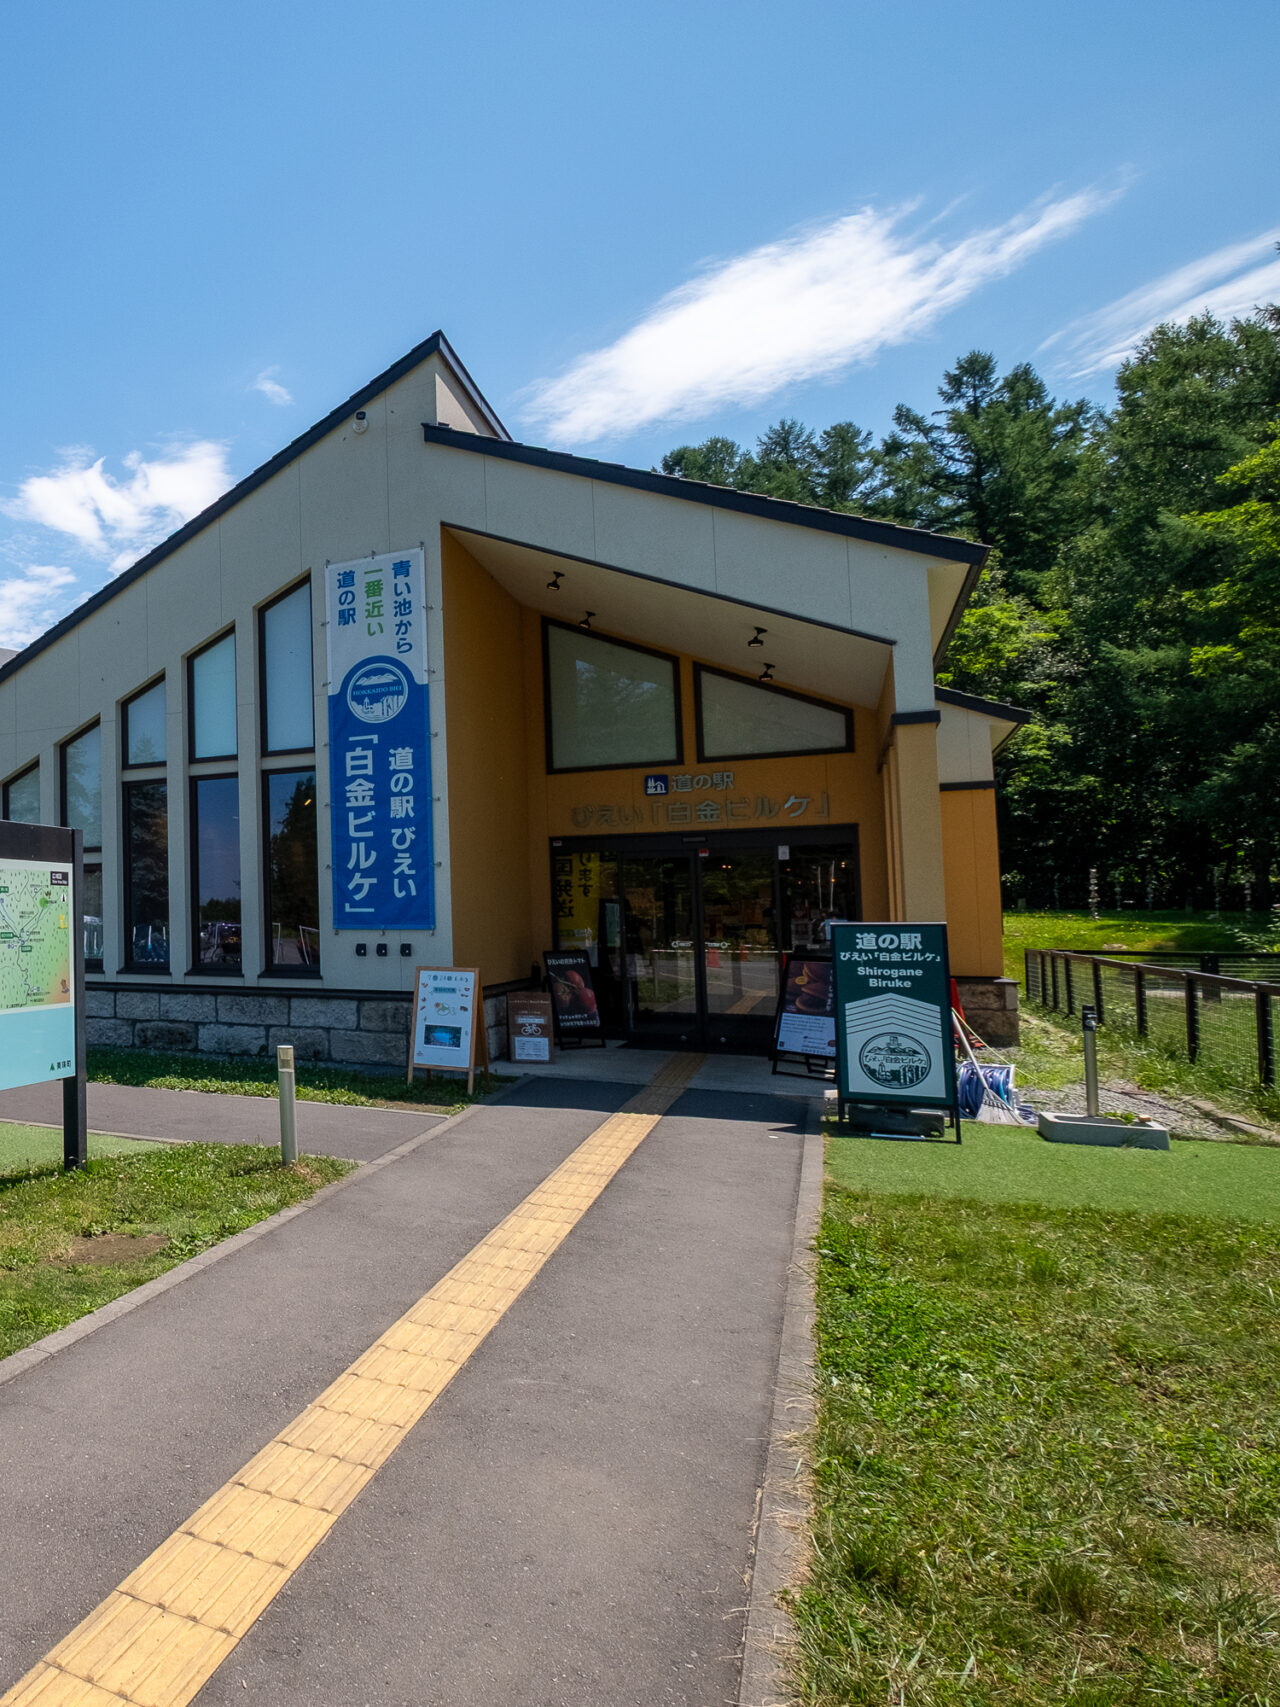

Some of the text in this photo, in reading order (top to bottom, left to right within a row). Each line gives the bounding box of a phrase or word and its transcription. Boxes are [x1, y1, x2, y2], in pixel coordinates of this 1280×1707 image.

[337, 569, 356, 626] 道の駅
[364, 568, 384, 637] 一番近い
[392, 560, 413, 654] 青い池から
[353, 686, 388, 696] HOKKAIDO
[672, 771, 734, 793] 道の駅
[345, 734, 379, 913] 「白金ビルケ」
[389, 746, 417, 898] 道の駅 びえい
[573, 792, 829, 828] びえい「白金ビルケ」
[856, 932, 923, 950] 道の駅
[840, 951, 941, 962] びえい「白金ビルケ」
[857, 966, 923, 978] Shirogane
[869, 978, 912, 988] Biruke
